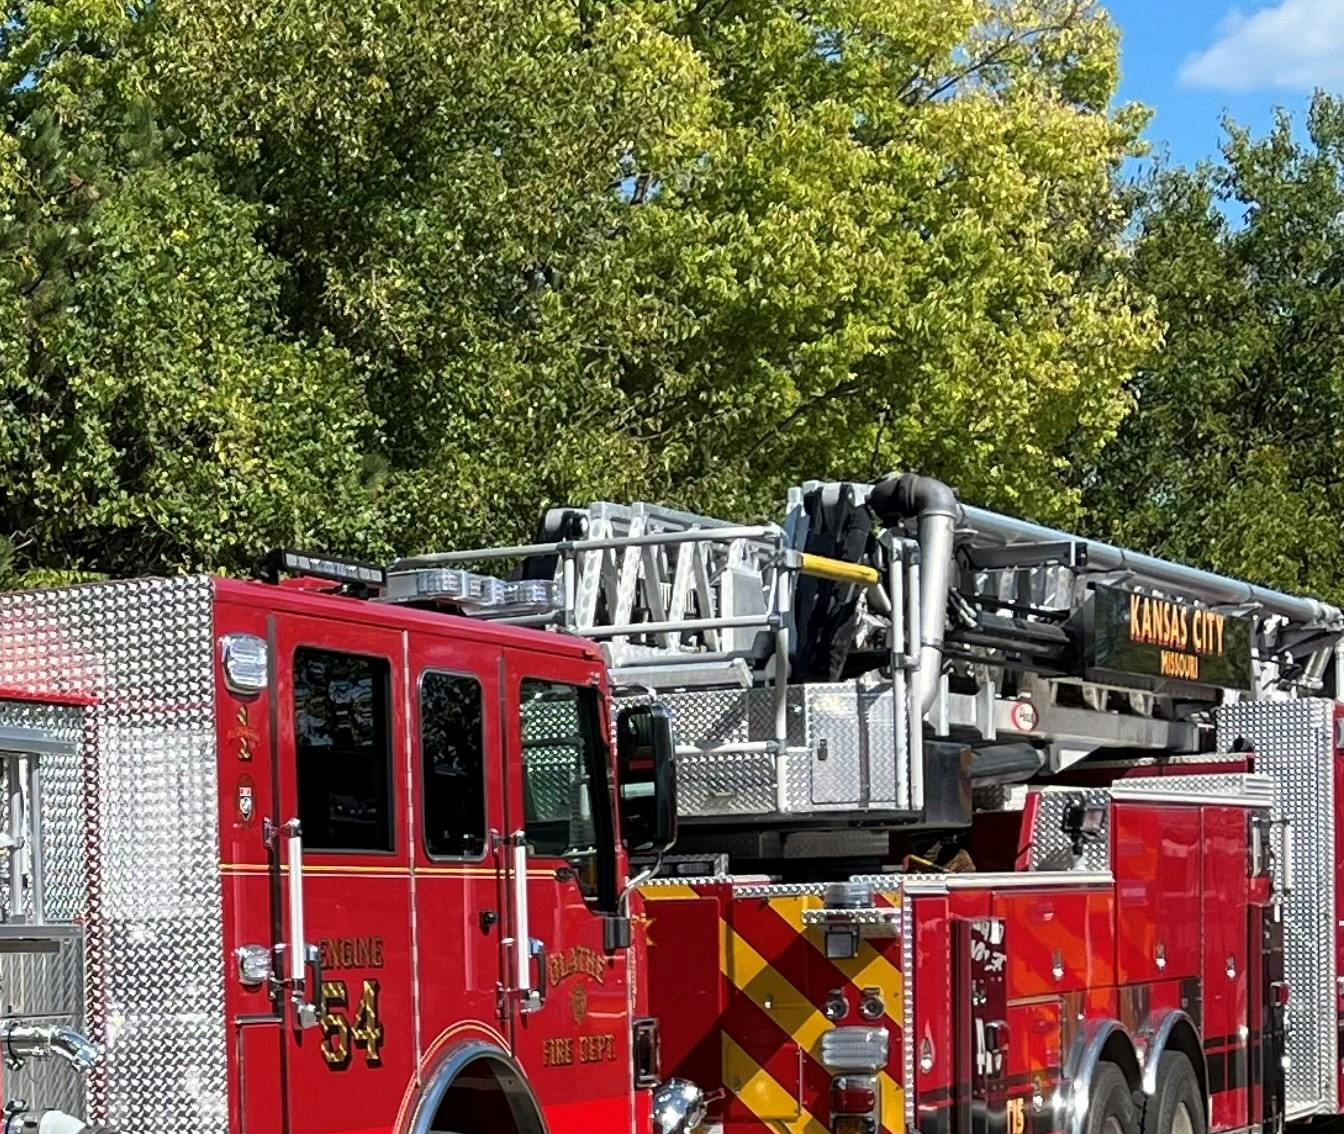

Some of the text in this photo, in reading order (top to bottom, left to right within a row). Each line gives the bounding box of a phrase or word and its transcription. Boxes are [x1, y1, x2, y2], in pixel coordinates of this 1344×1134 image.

[1129, 593, 1226, 657] KANSAS CITY
[1160, 649, 1200, 680] MISSOURI
[319, 936, 384, 969] ENGINE
[548, 946, 608, 987] OLATHE
[319, 979, 385, 1071] 54
[543, 1037, 574, 1067] FIRE
